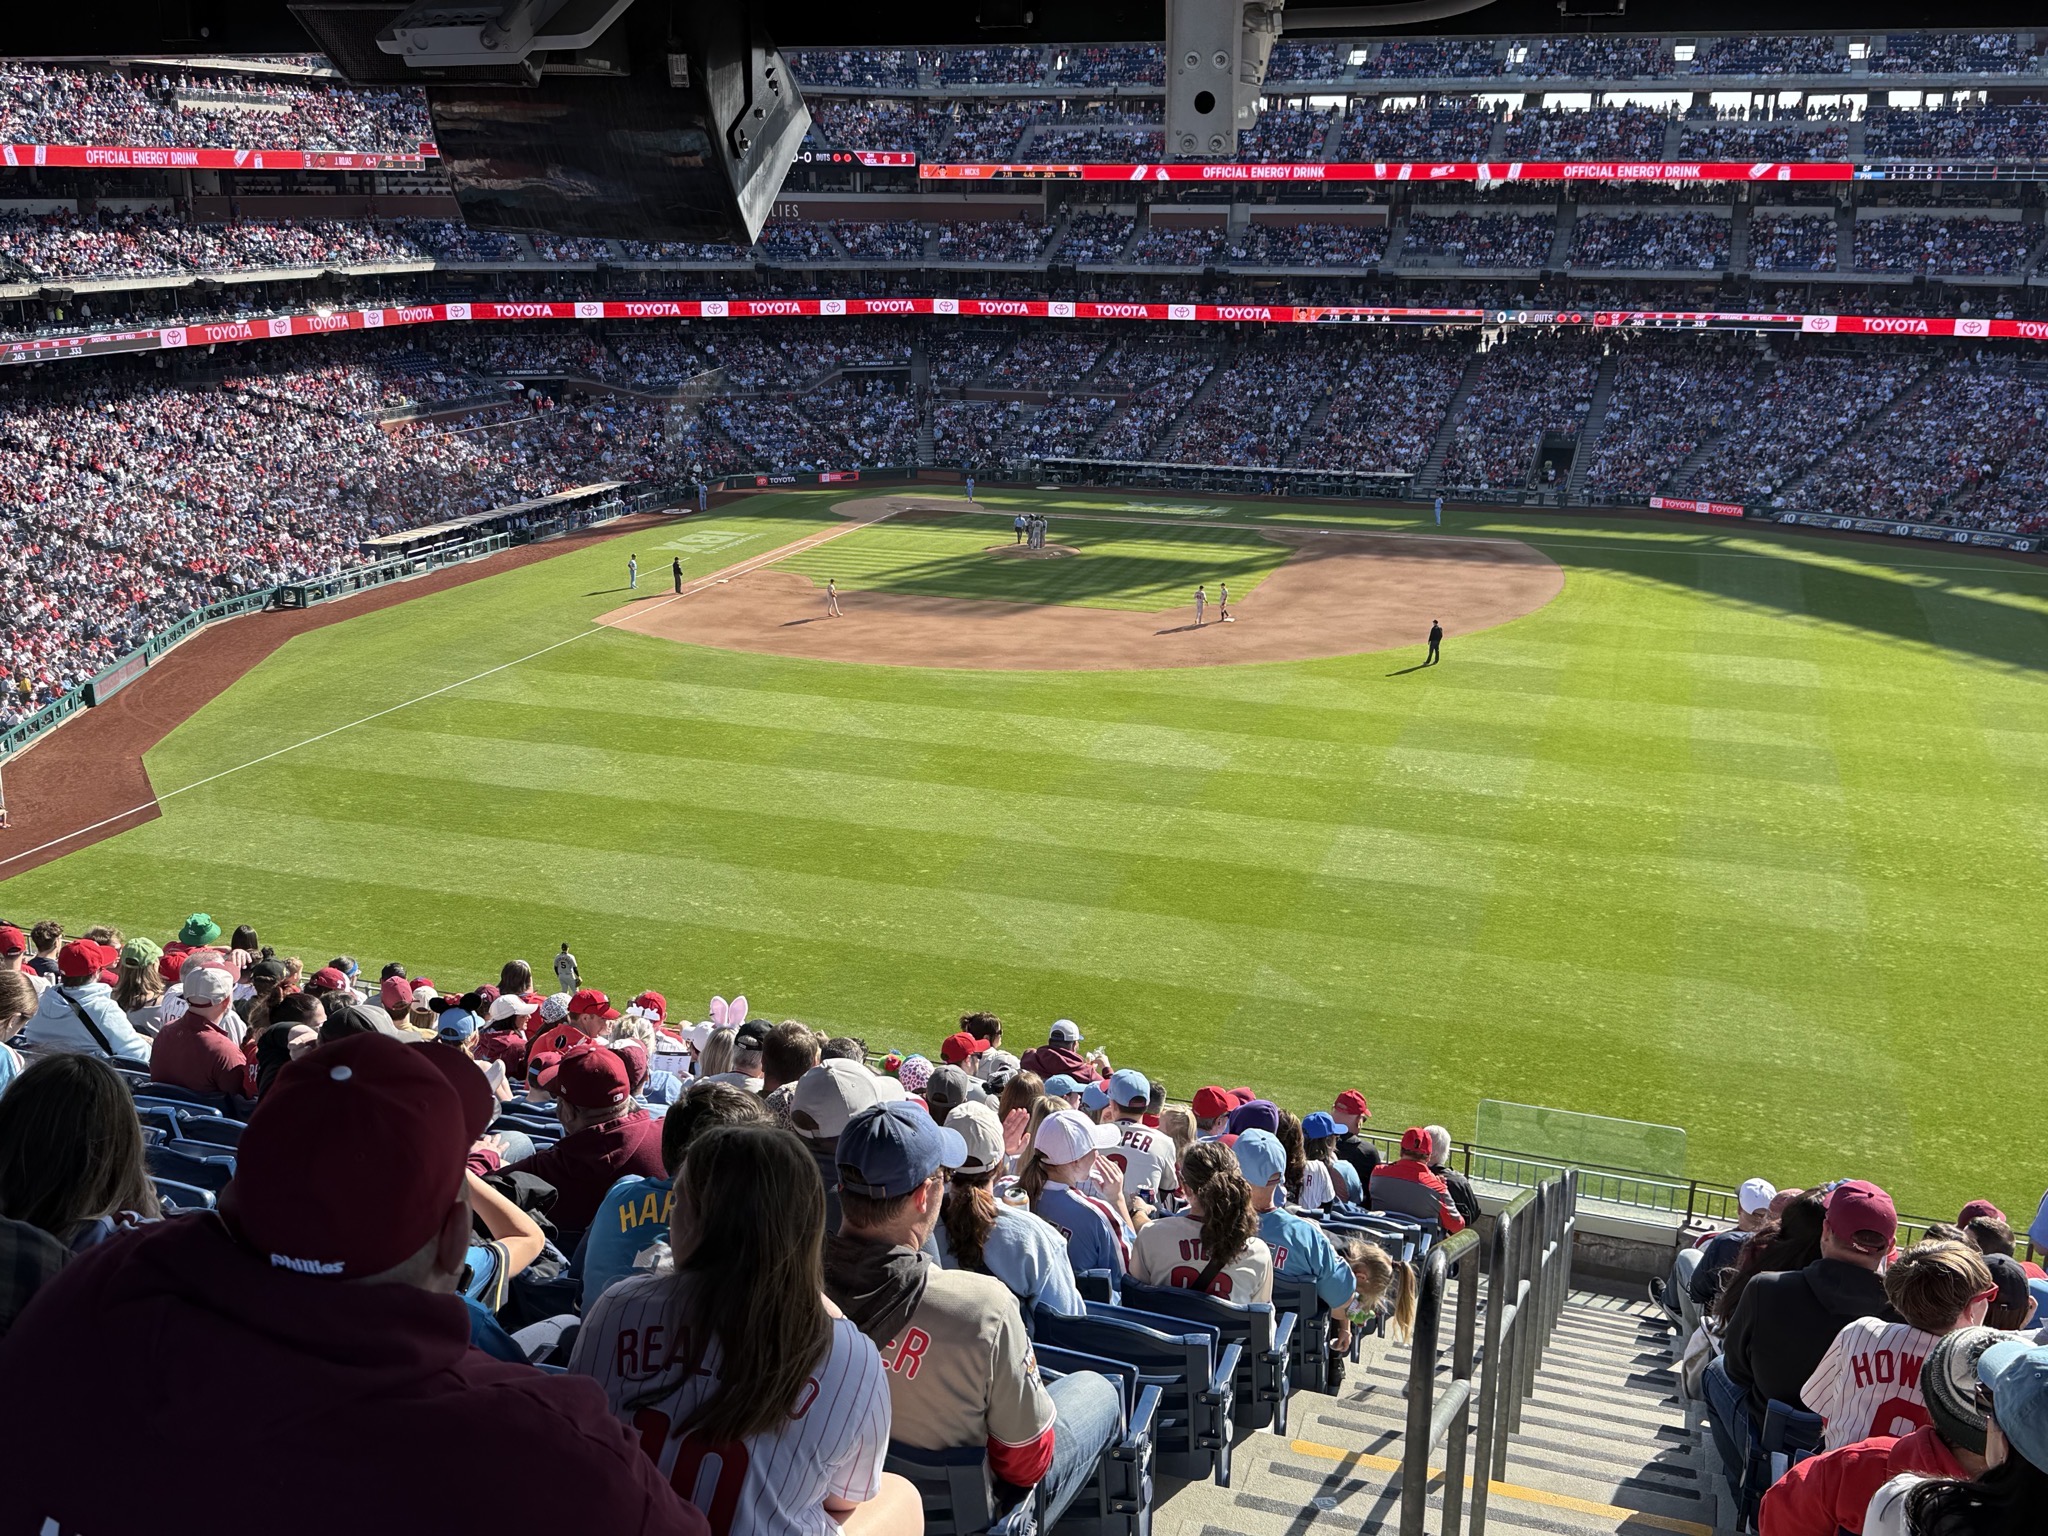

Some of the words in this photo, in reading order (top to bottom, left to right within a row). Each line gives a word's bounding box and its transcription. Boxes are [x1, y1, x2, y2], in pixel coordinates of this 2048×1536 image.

[86, 150, 131, 164] OFFICIAL
[132, 151, 169, 165] ENERGY
[170, 152, 199, 165] DRINK
[816, 153, 831, 162] OUTS
[901, 154, 907, 163] 5
[1203, 167, 1249, 178] OFFICIAL
[1250, 167, 1291, 178] ENERGY
[1293, 167, 1325, 178] DRINK
[1563, 166, 1615, 177] OFFICIAL
[1619, 166, 1662, 177] ENERGY
[1664, 166, 1702, 178] DRINK
[494, 304, 553, 317] TOYOTA
[625, 303, 681, 316] TOYOTA
[748, 302, 801, 314] TOYOTA
[865, 300, 915, 313] TOYOTA
[978, 301, 1029, 314] TOYOTA
[1095, 304, 1148, 317] TOYOTA
[396, 308, 434, 321] TOYOTA
[1216, 306, 1272, 320] TOYOTA
[1534, 313, 1553, 323] OUTS
[307, 315, 349, 331] TOYOTA
[1862, 318, 1929, 333] TOYOTA
[205, 325, 253, 340] TOYOTA
[12, 352, 26, 361] .263
[69, 347, 82, 355] .333
[769, 476, 796, 484] TOYOTA
[1665, 501, 1696, 510] TOYOTA
[1712, 505, 1743, 515] TOYOTA
[1784, 513, 1796, 523] 10
[1839, 519, 1852, 529] 10
[1896, 525, 1909, 536] 10
[1954, 532, 1968, 543] 10
[2015, 540, 2030, 551] 10
[560, 961, 567, 969] 5
[1119, 1130, 1153, 1153] PER
[270, 1253, 345, 1274] Phillies
